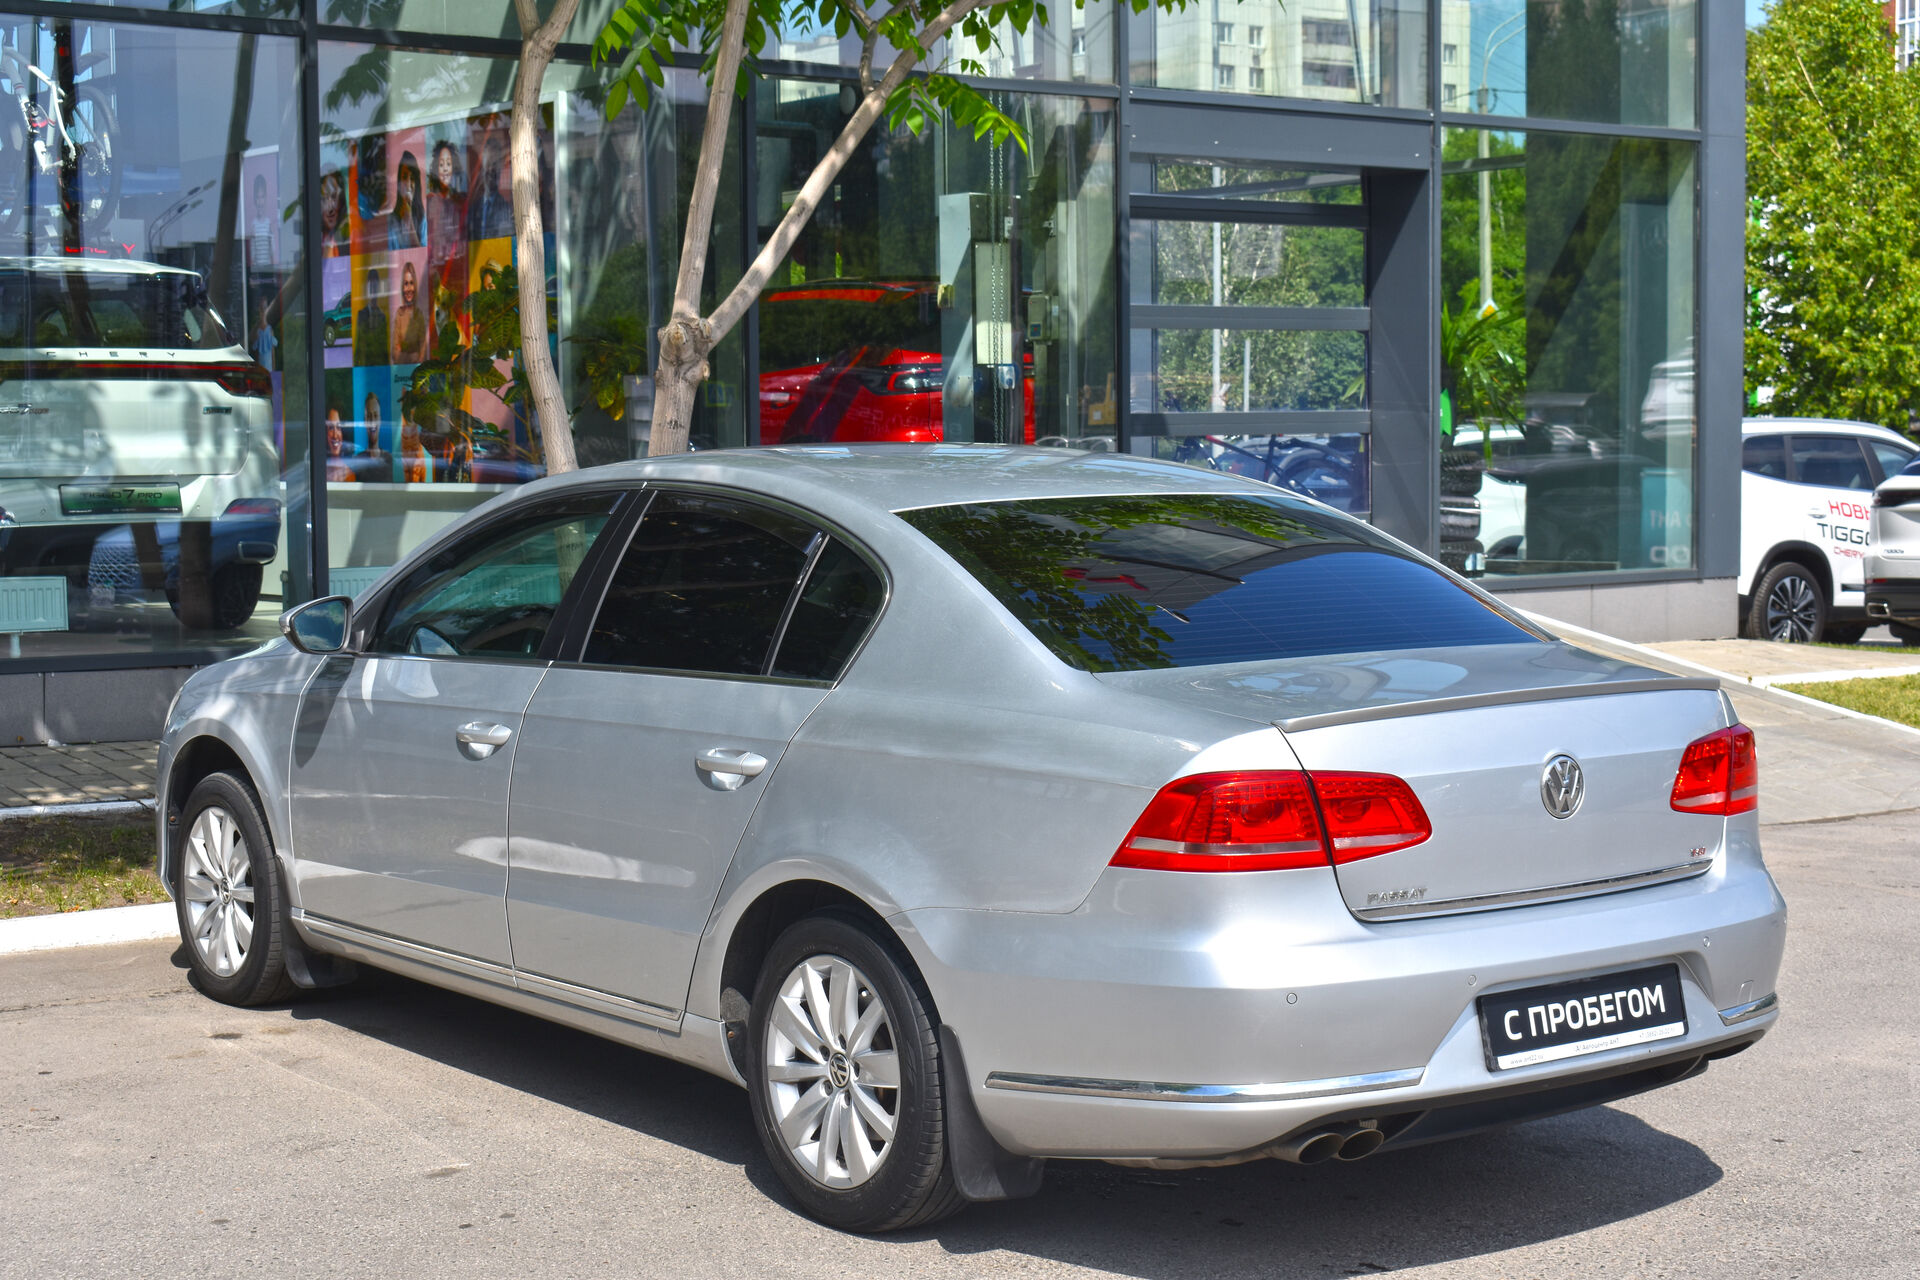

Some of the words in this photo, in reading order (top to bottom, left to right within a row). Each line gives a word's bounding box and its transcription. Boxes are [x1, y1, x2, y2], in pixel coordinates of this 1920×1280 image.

[122, 489, 135, 499] 7
[137, 491, 162, 499] PRO
[1367, 887, 1428, 904] PASSAT
[1504, 1009, 1523, 1041] С
[1527, 984, 1667, 1038] ПРОБЕГОМ
